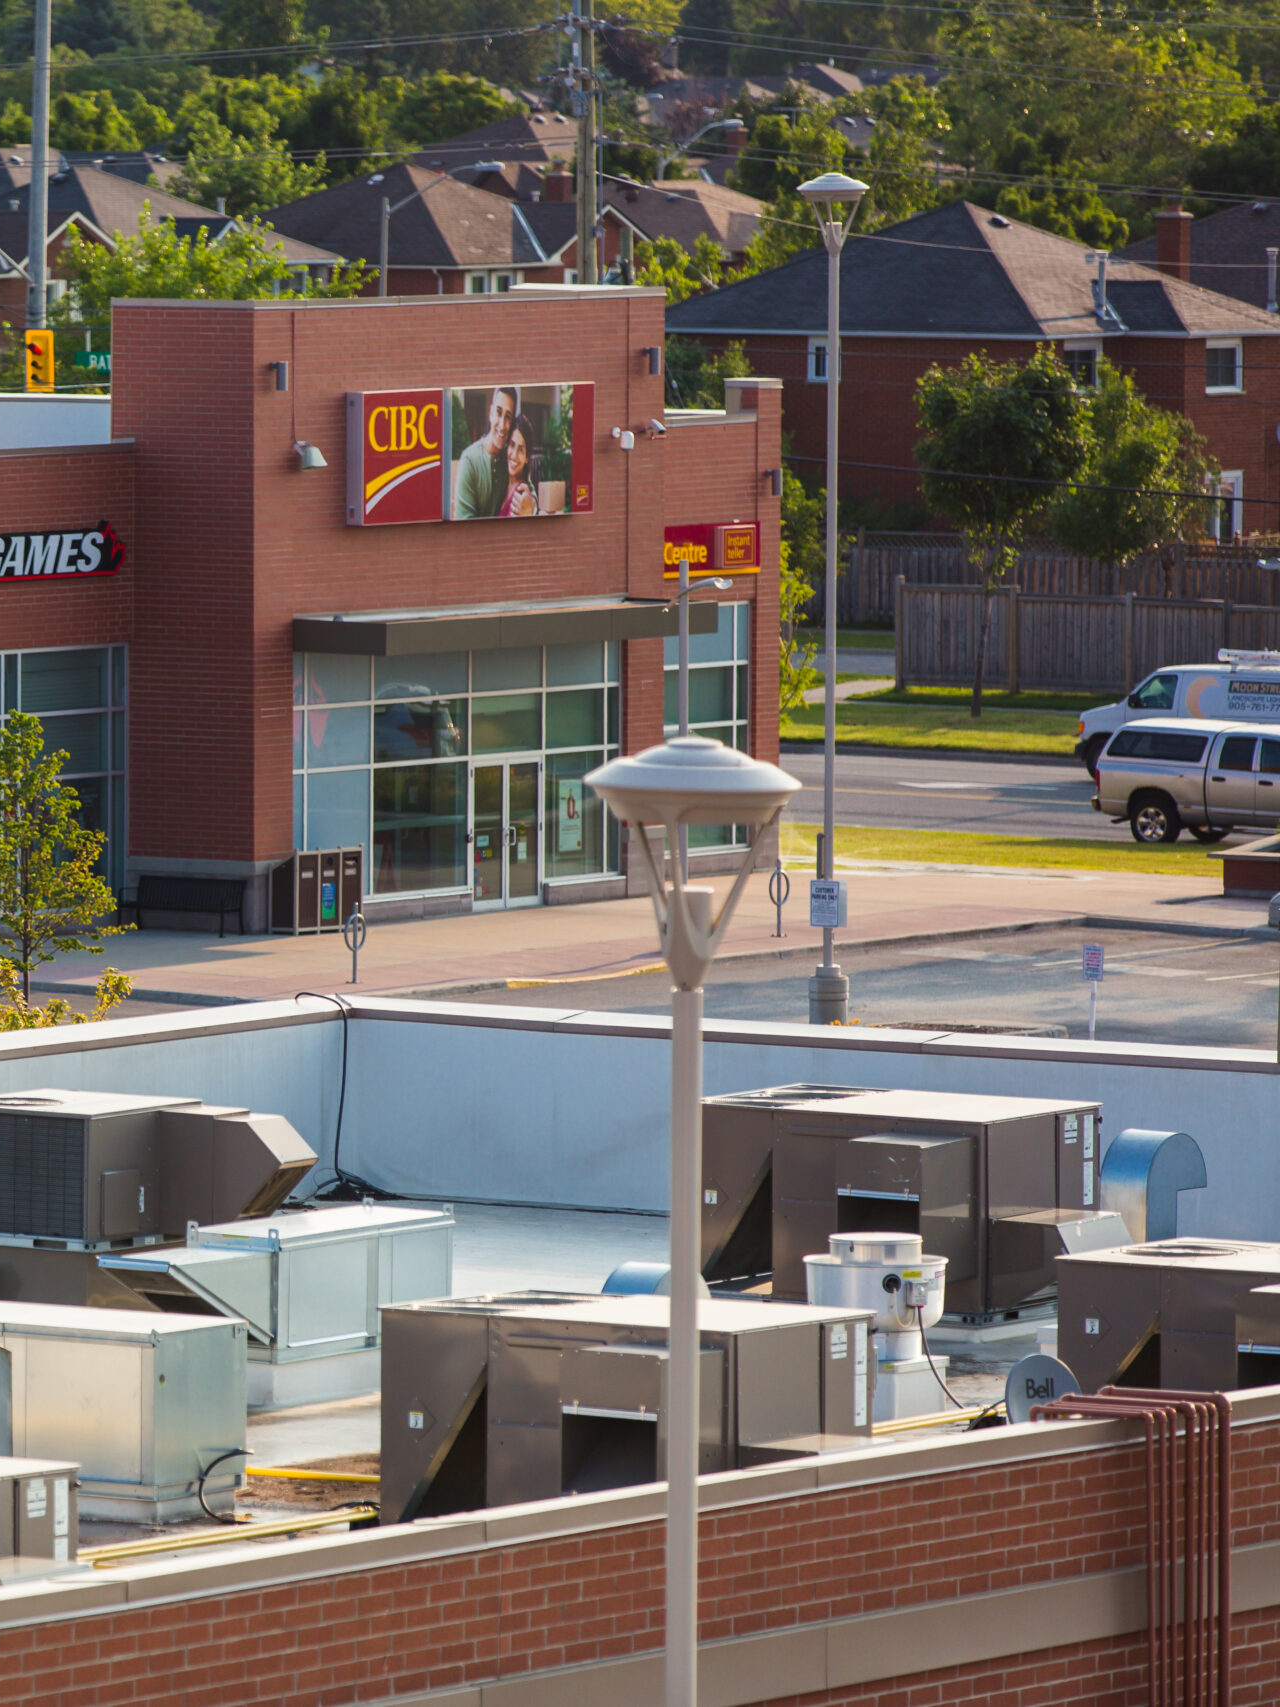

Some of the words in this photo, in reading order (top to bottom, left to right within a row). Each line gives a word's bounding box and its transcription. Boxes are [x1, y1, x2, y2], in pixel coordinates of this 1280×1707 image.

[368, 403, 438, 452] CIBC
[727, 535, 751, 546] Instant
[664, 542, 707, 565] Centre
[727, 548, 745, 559] teller
[1231, 682, 1259, 693] MOON
[1227, 694, 1265, 702] LANDSCAPE
[1025, 1377, 1055, 1399] Bell
